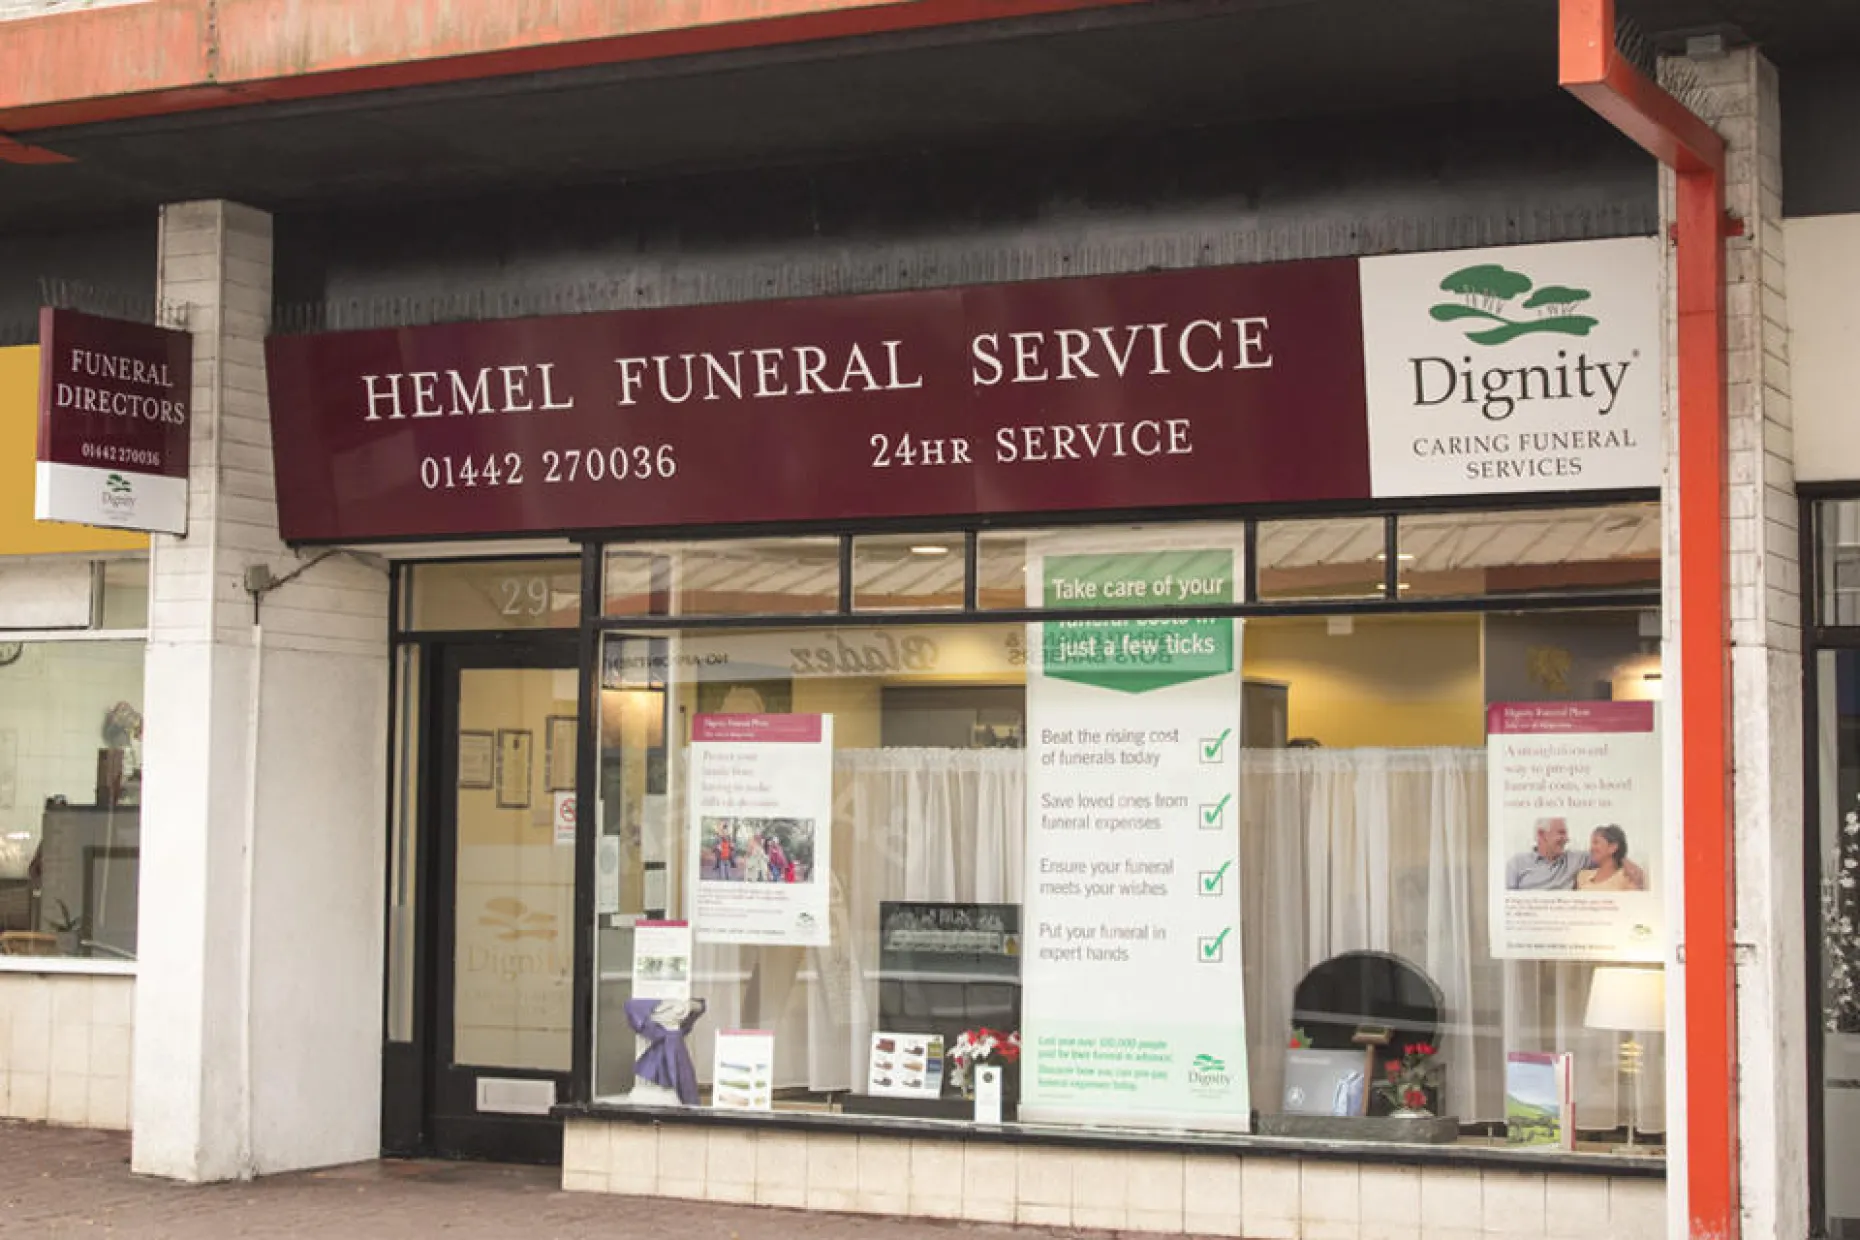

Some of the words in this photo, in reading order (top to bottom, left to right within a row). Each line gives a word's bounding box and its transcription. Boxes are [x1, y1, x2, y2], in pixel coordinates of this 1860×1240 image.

[71, 348, 174, 388] FUNERAL
[361, 363, 574, 421] HEMEL
[614, 340, 922, 406] FUNERAL
[971, 316, 1273, 386] SERVICE
[1408, 348, 1631, 421] Dignity
[56, 382, 186, 425] DIRECTORS
[870, 432, 972, 468] 24HR
[997, 418, 1194, 464] SERVICE
[1412, 433, 1510, 457] CARING
[1518, 427, 1638, 453] FUNERAL
[420, 452, 524, 489] 01442
[542, 444, 677, 482] 270036
[1466, 456, 1583, 480] SERVICES
[501, 576, 548, 618] 29
[1051, 577, 1097, 601] Take
[1103, 579, 1147, 598] care
[1152, 574, 1173, 597] of
[1177, 576, 1225, 601] your
[1059, 633, 1097, 662] just
[1103, 639, 1116, 657] a
[1122, 634, 1160, 657] few
[1166, 631, 1216, 655] ticks
[1041, 728, 1074, 745] Beat
[1077, 729, 1101, 744] the
[1105, 729, 1146, 746] rising
[1149, 728, 1179, 744] cost
[1041, 750, 1056, 766] of
[1059, 749, 1116, 765] funerals
[1120, 750, 1161, 768] today
[1040, 792, 1074, 809] Save
[1077, 792, 1114, 808] loved
[1117, 795, 1151, 809] ones
[1154, 792, 1189, 808] from
[1041, 814, 1090, 831] funeral
[1094, 816, 1162, 833] expenses
[1039, 857, 1087, 874] Ensure
[1090, 861, 1120, 878] your
[1124, 857, 1174, 875] funeral
[1039, 880, 1082, 896] meets
[1084, 882, 1115, 899] your
[1119, 879, 1169, 896] wishes
[1039, 922, 1063, 939] Put
[1066, 925, 1096, 942] your
[1099, 923, 1150, 940] funeral
[1151, 924, 1167, 939] in
[1039, 946, 1082, 963] expert
[1086, 946, 1130, 963] hands
